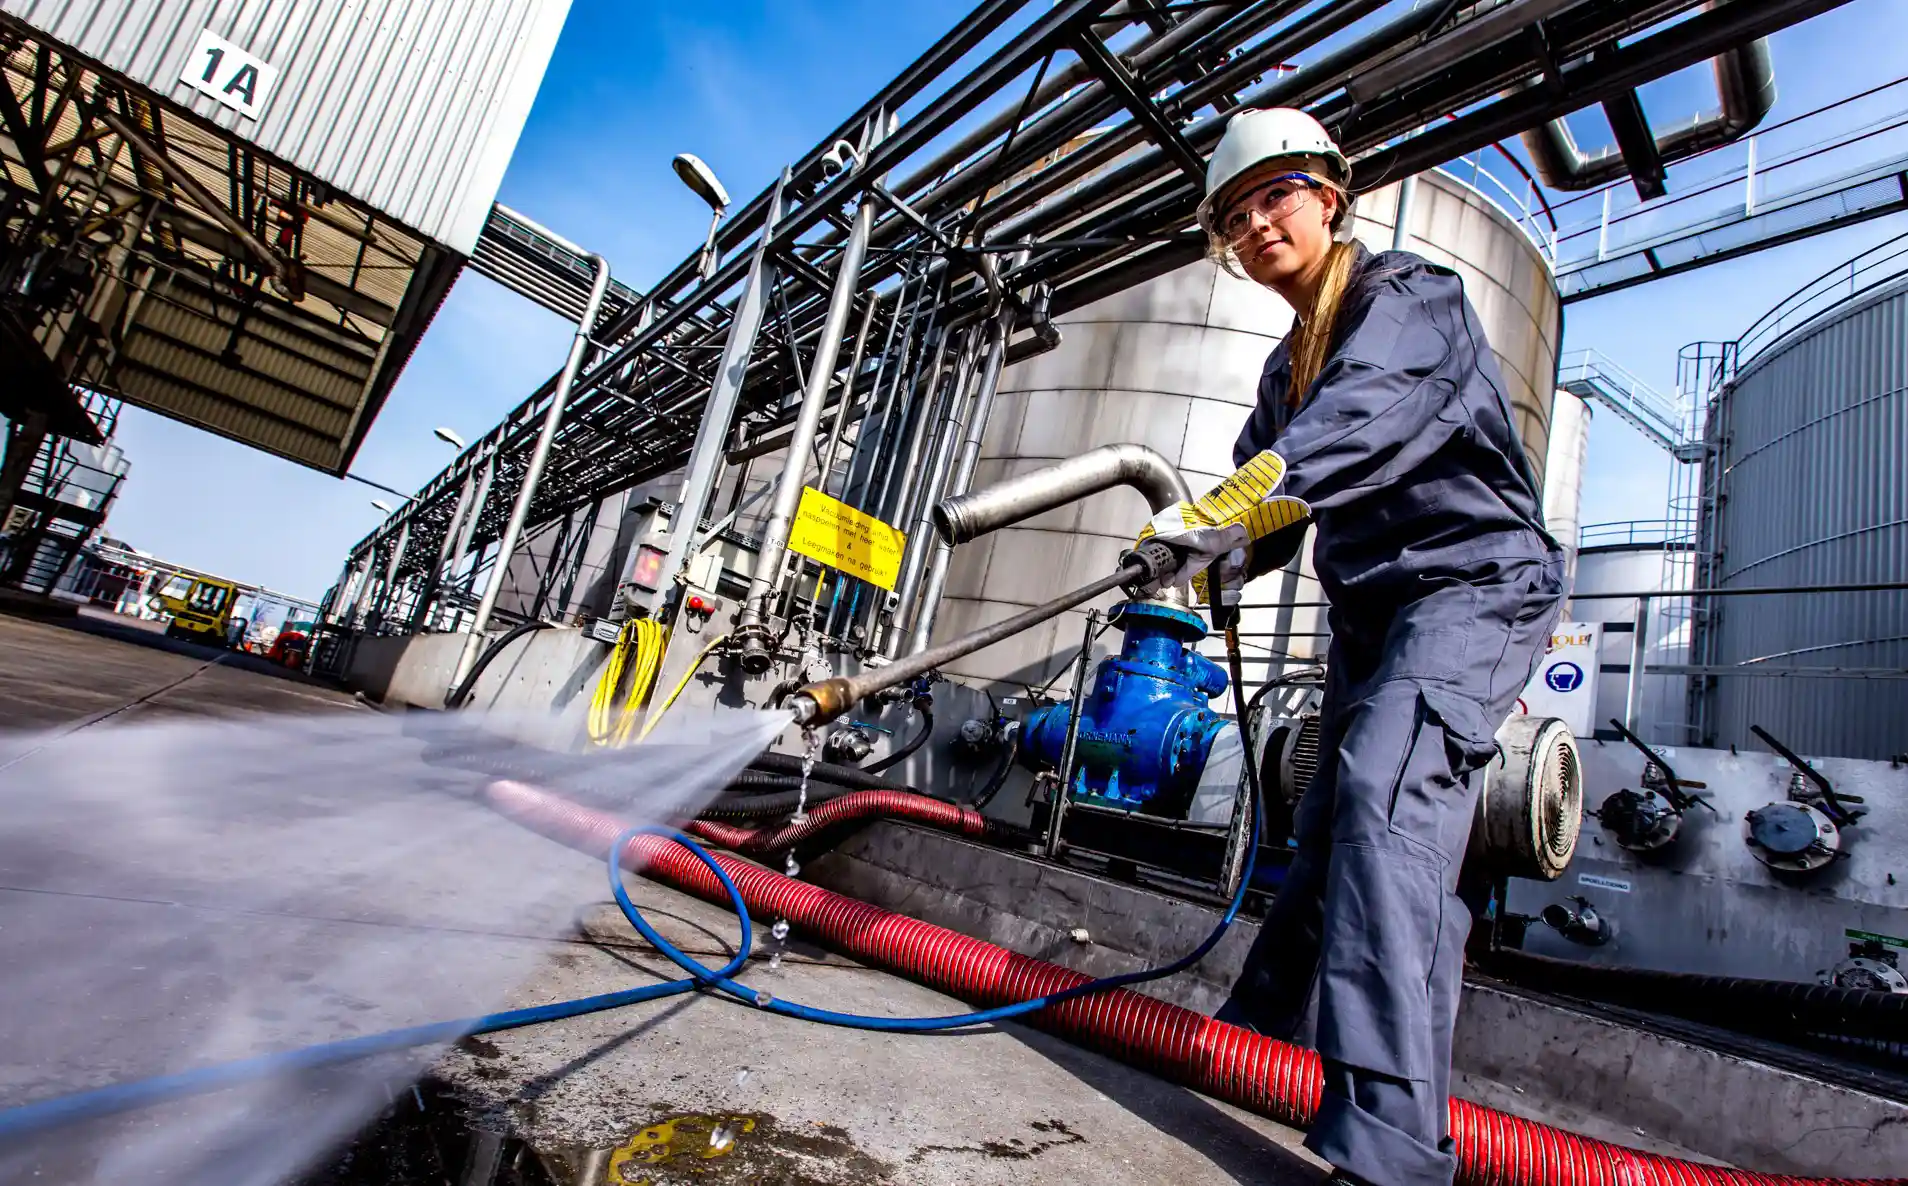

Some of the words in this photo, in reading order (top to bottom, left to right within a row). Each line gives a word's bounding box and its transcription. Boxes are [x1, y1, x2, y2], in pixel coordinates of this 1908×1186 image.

[201, 47, 260, 107] 1A
[843, 528, 857, 539] met
[802, 536, 844, 561] Leegmaken
[847, 556, 856, 566] na
[846, 542, 852, 550] &
